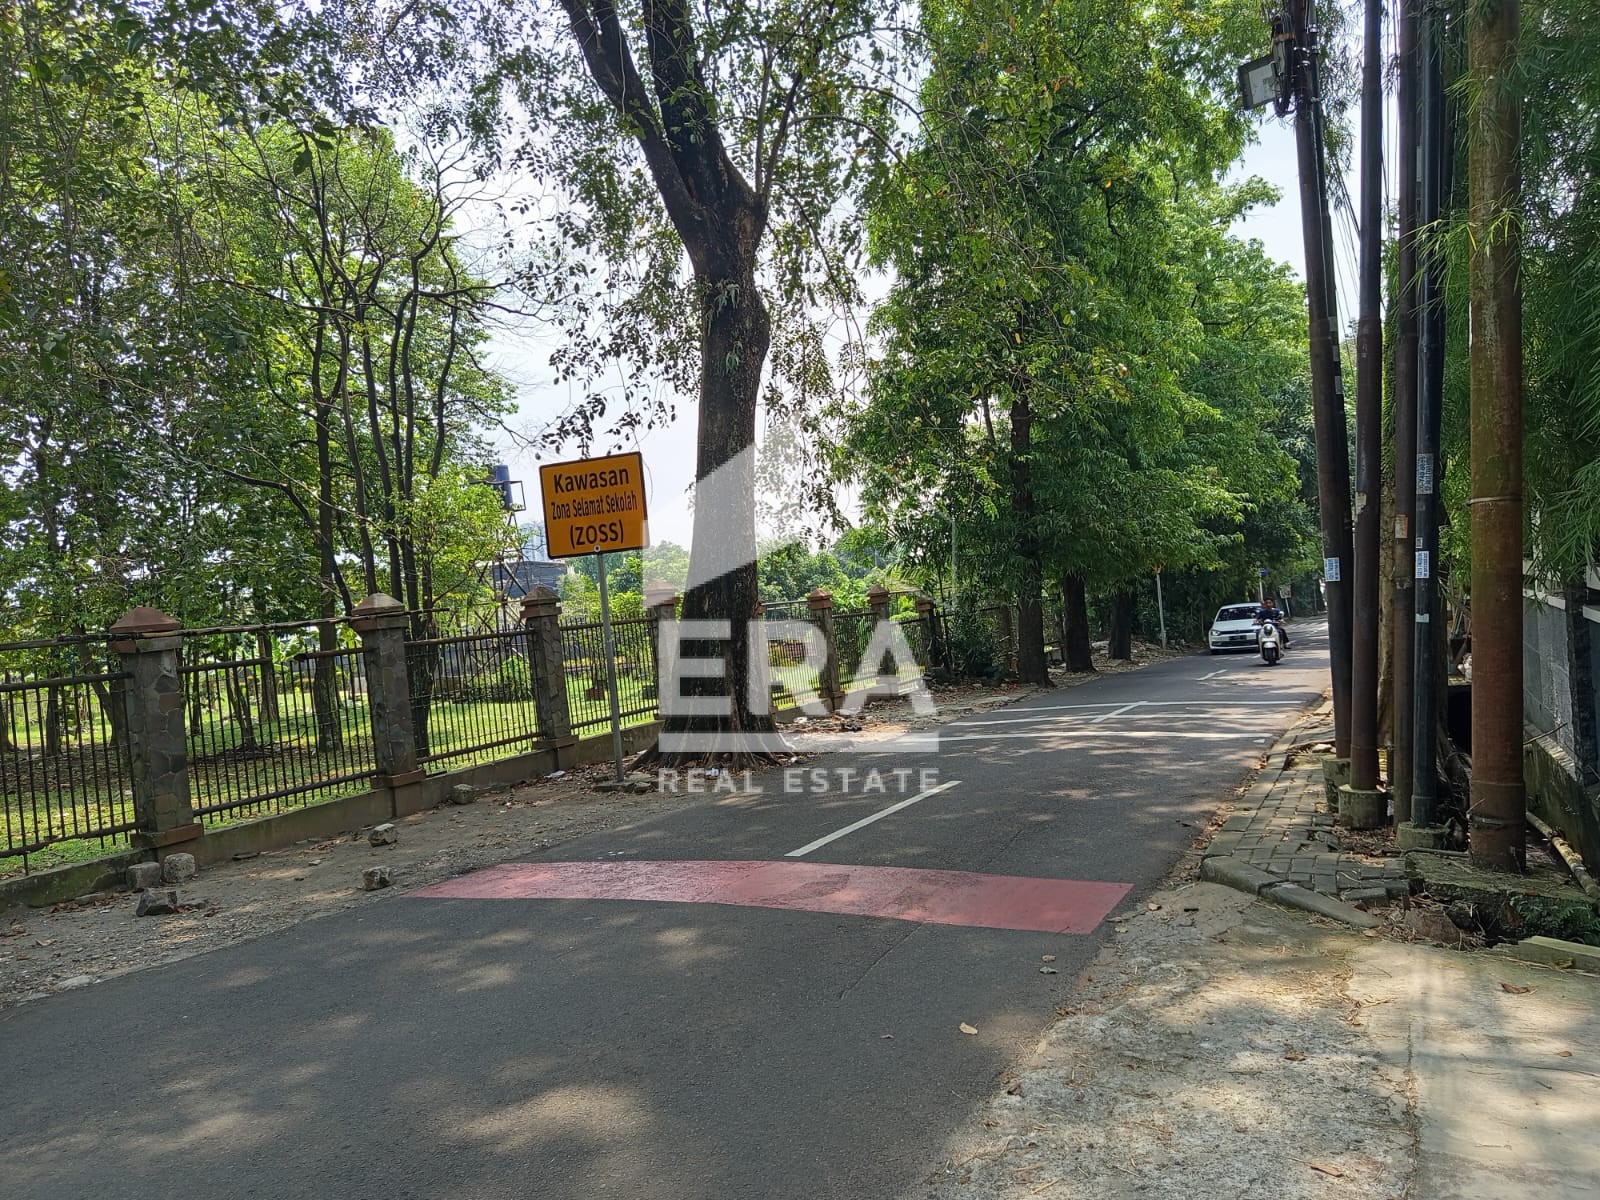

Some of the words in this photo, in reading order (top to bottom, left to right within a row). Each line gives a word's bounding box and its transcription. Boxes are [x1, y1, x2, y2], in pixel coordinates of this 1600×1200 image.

[553, 467, 629, 494] Kawasan
[551, 501, 571, 520] Zona
[572, 497, 605, 517] Selamat
[606, 490, 638, 513] Sekolah
[570, 519, 624, 549] (ZOSS)
